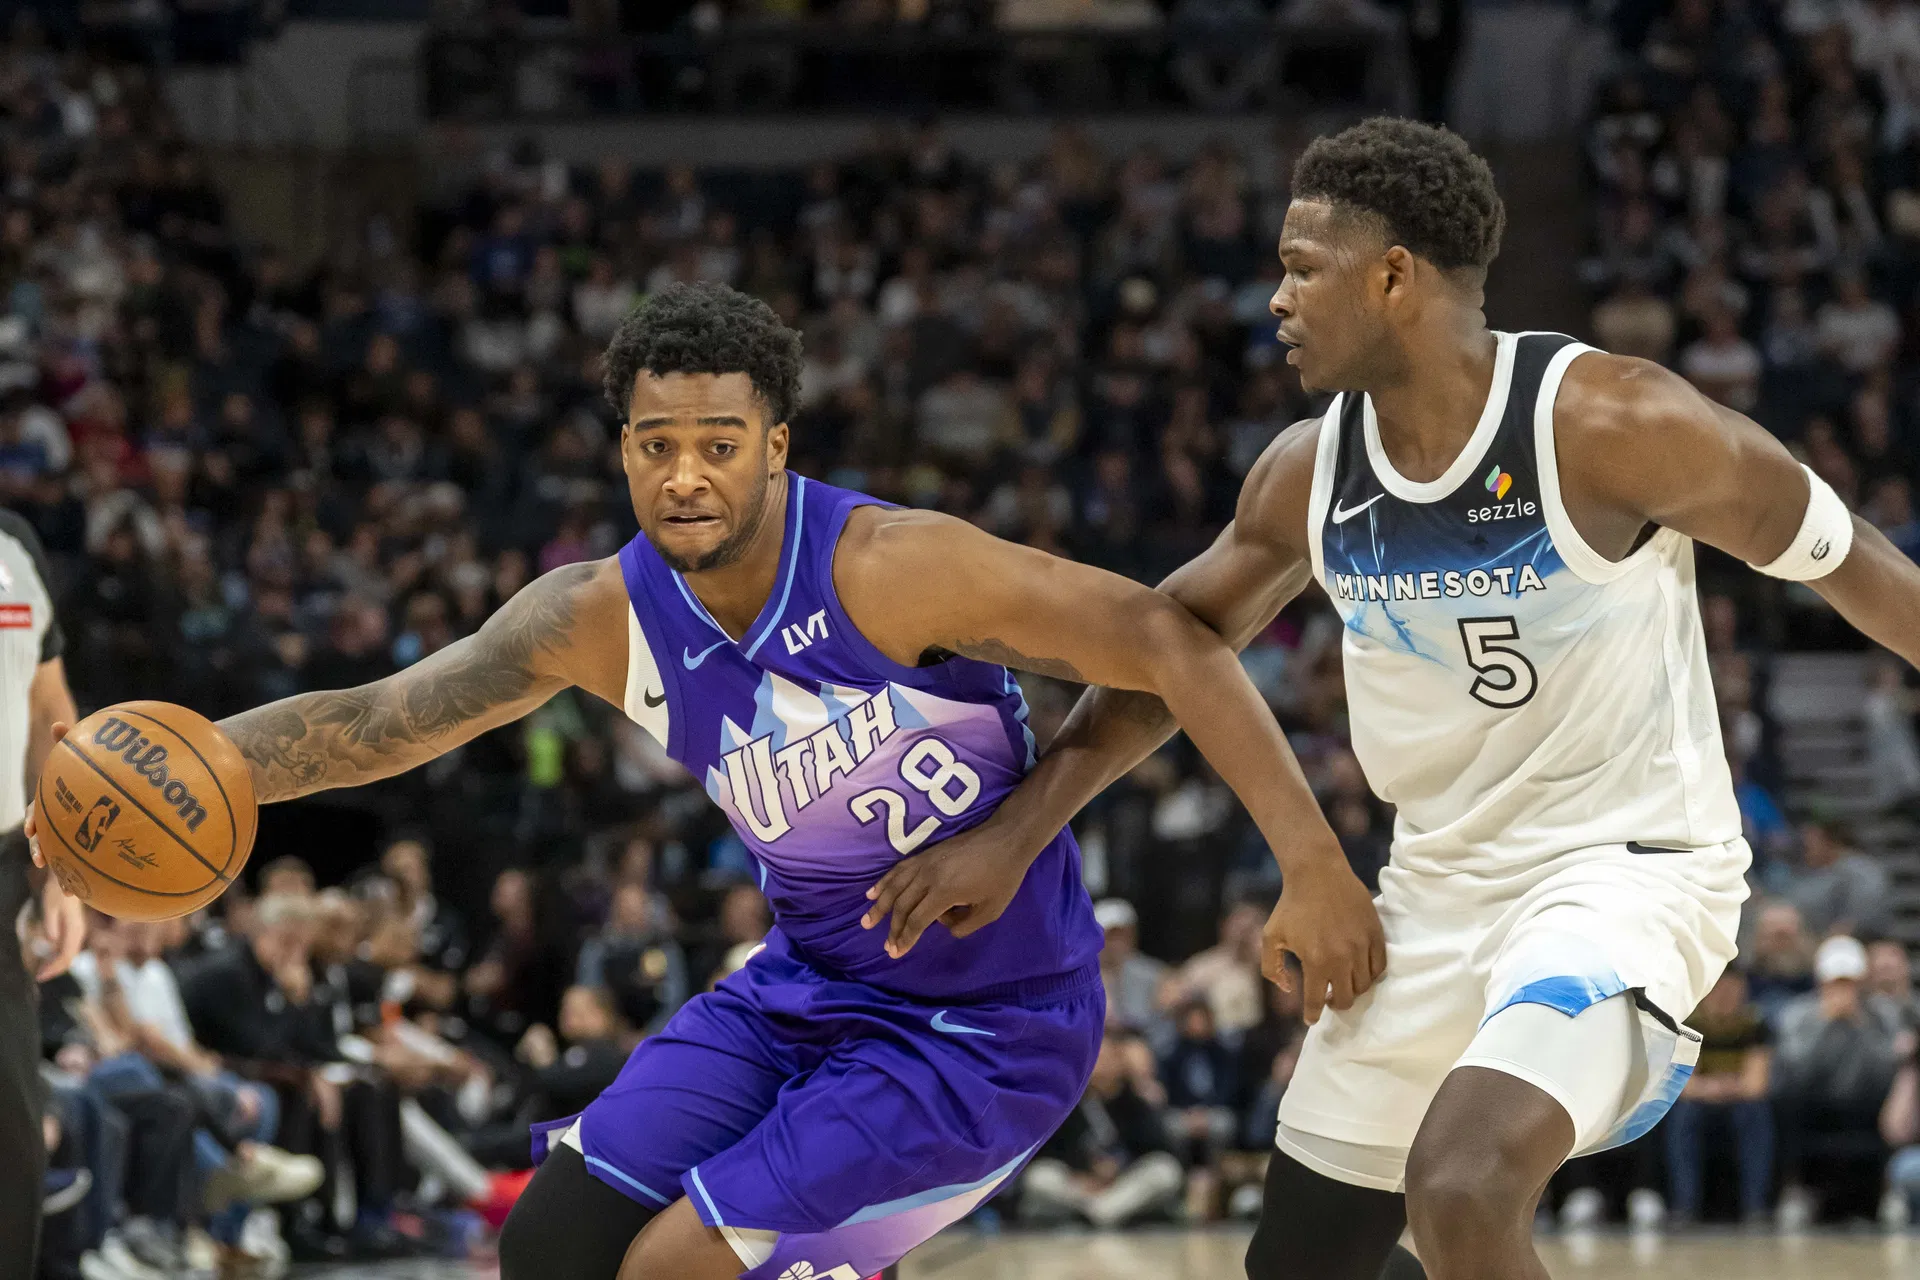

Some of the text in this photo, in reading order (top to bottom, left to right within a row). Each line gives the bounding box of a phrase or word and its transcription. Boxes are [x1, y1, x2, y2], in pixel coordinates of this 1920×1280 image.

[1468, 498, 1536, 523] sezzle
[1335, 563, 1547, 602] MINNESOTA
[781, 609, 829, 656] LVT
[1457, 615, 1538, 709] 5
[92, 717, 208, 835] Wilson
[721, 681, 901, 844] UTAH
[847, 735, 982, 859] 28
